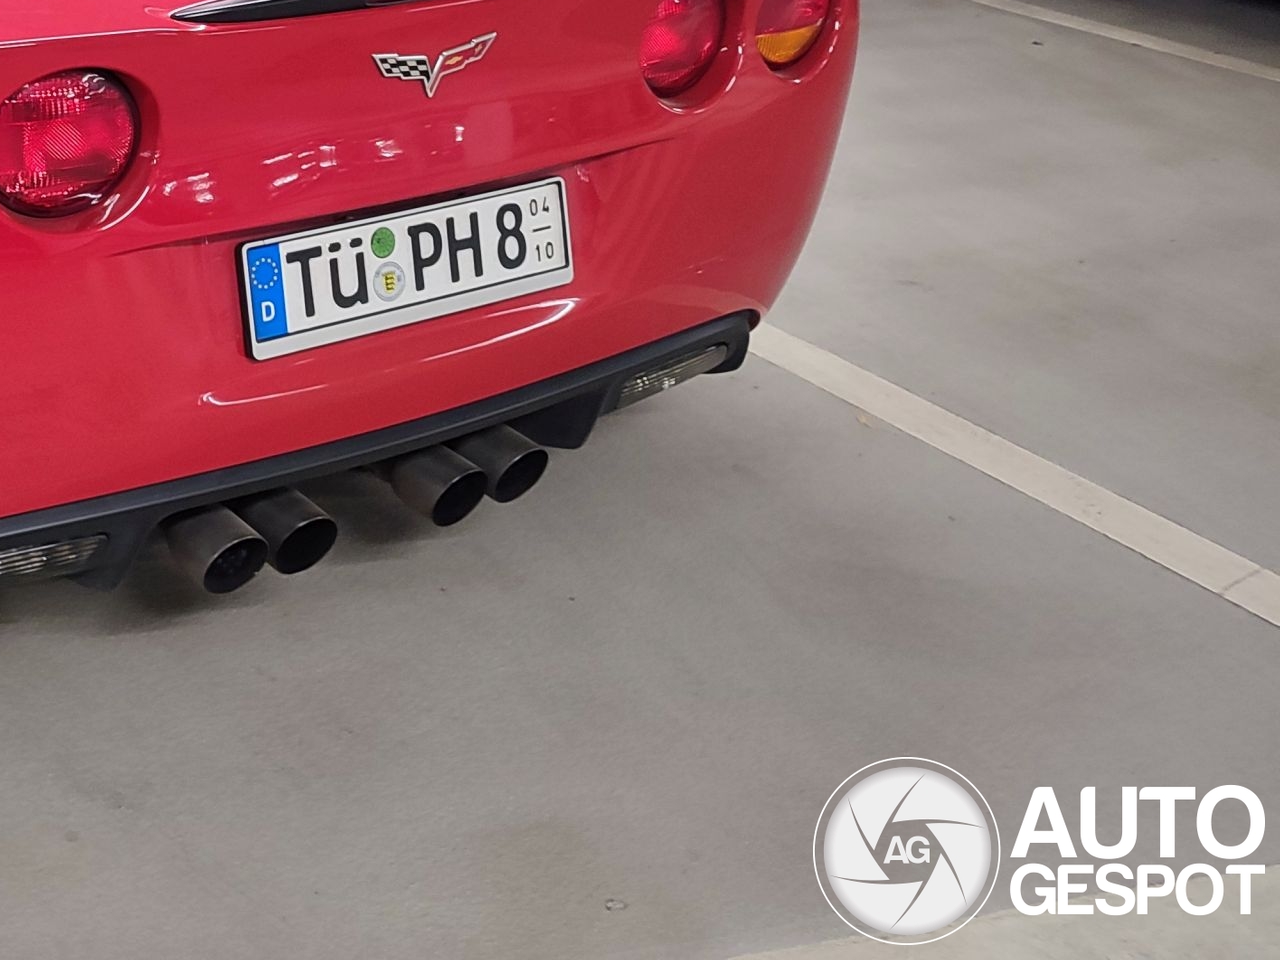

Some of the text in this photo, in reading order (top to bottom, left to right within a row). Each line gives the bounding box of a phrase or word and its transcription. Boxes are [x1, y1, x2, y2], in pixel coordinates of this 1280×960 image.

[529, 196, 550, 217] 04
[407, 211, 484, 292] PH
[496, 202, 528, 270] 8
[534, 241, 555, 263] 10
[261, 301, 276, 322] D
